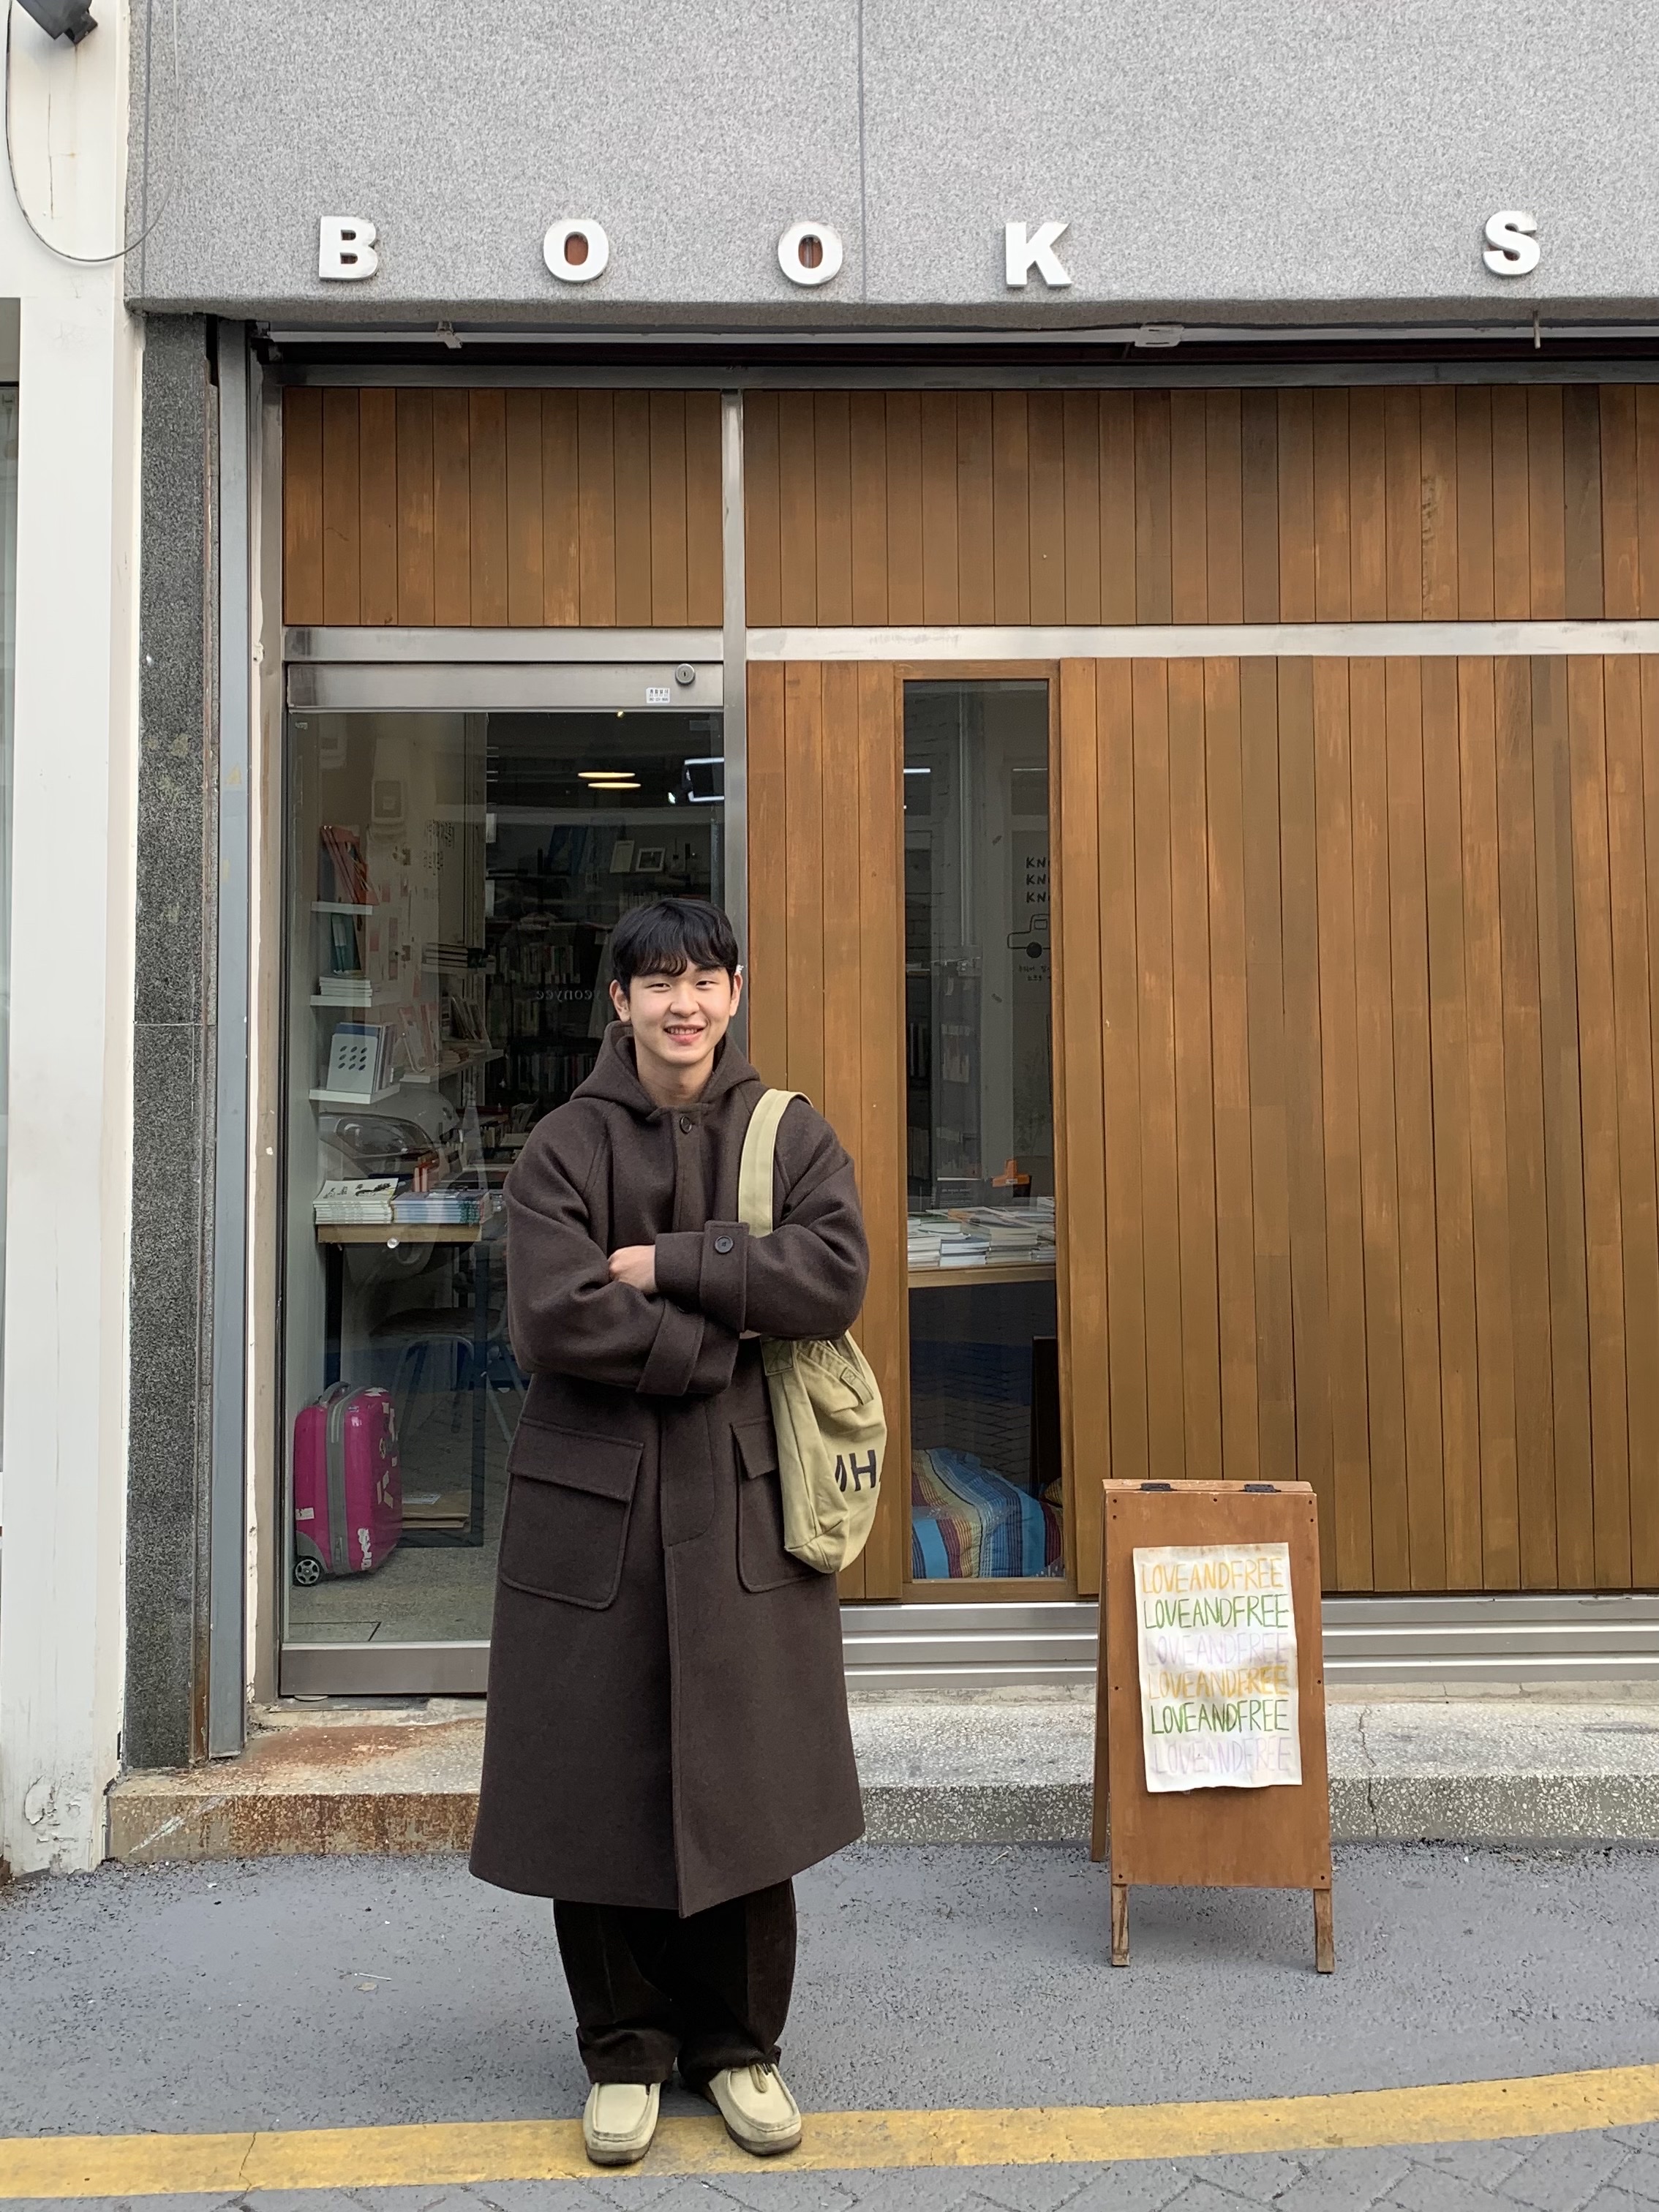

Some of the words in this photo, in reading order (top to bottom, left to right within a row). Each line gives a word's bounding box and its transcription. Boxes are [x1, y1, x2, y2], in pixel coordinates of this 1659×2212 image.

[1026, 856, 1050, 869] KN
[1026, 873, 1050, 886] KN
[1026, 891, 1050, 903] KN
[1141, 1557, 1284, 1594] LOVEANDFREE
[1143, 1594, 1290, 1629] LOVEANDFREE
[1145, 1632, 1289, 1666] LOVEANDFREE
[1148, 1665, 1290, 1700] LOVEANDFREE
[1151, 1699, 1290, 1734] LOVEANDFREE
[1154, 1737, 1292, 1774] LOVEANDFREE
